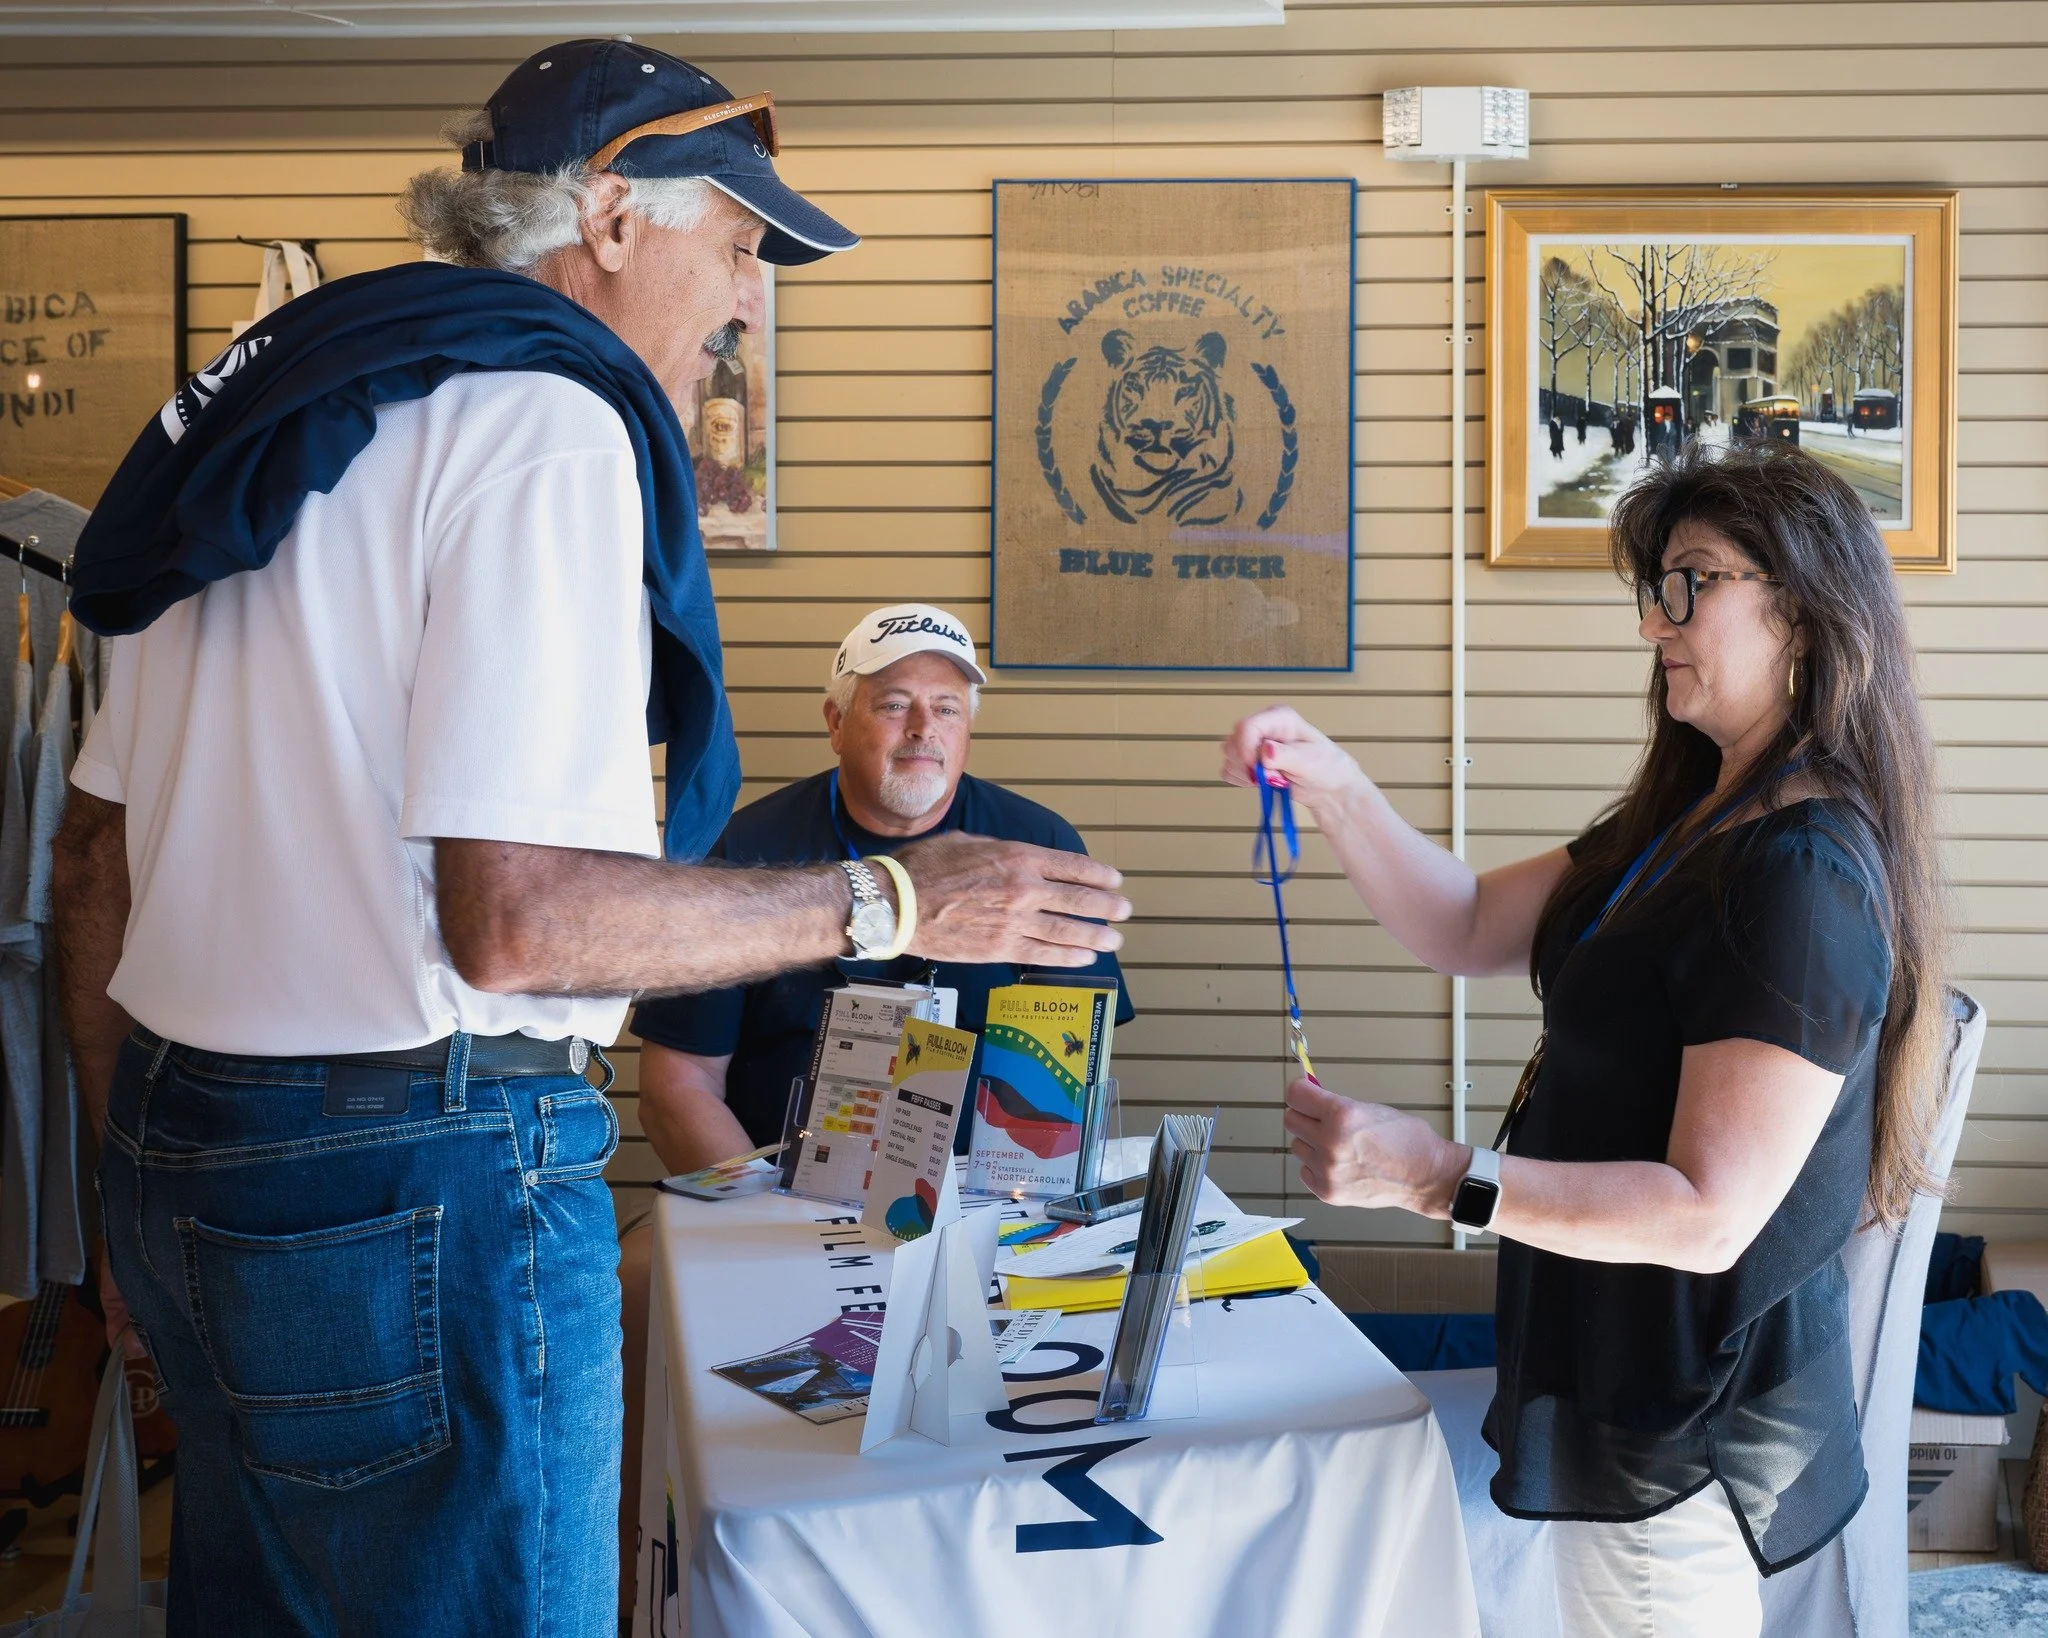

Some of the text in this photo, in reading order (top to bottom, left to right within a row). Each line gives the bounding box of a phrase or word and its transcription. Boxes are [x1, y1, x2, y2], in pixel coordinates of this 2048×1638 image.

[703, 102, 753, 121] ELECTRICITIES
[4, 290, 98, 324] BICA
[1057, 265, 1286, 340] ARABICA SPECIALTY
[1121, 290, 1206, 320] COFFEE
[0, 327, 112, 366] CE OF
[1058, 548, 1286, 580] BLUE TIGER
[869, 614, 968, 647] Titleist
[851, 1012, 874, 1021] BLOOM
[999, 999, 1080, 1013] FULL BLOOM
[810, 998, 831, 1081] FESTIVAL SCHEDULE
[926, 1033, 969, 1056] FULL BLOOM
[1085, 1000, 1103, 1083] WELCOME MESSAGE
[923, 1097, 942, 1111] PASSES
[975, 1149, 1025, 1160] SEPTEMBER
[996, 1173, 1071, 1185] NORTH CAROLINA
[998, 1165, 1035, 1174] STATESVILLE
[814, 1216, 874, 1269] FILM
[1909, 1448, 1958, 1461] 10 Midd
